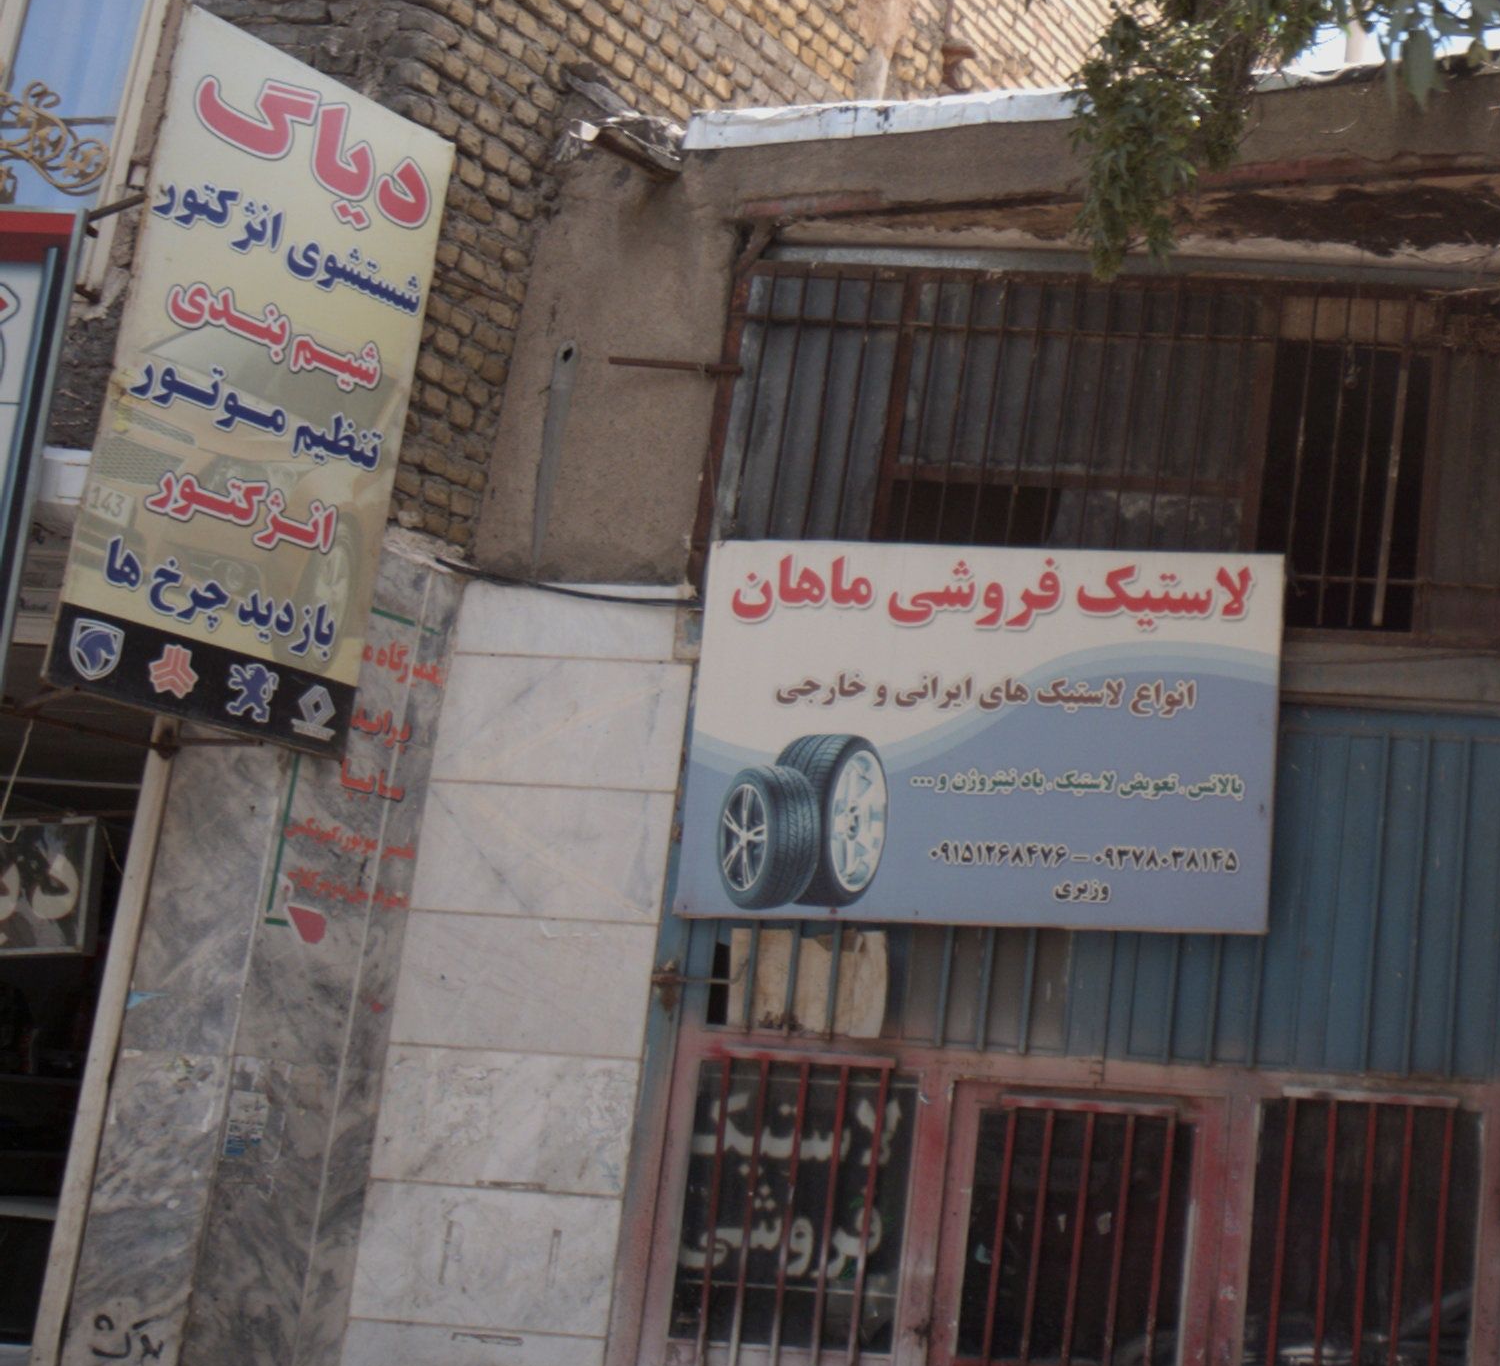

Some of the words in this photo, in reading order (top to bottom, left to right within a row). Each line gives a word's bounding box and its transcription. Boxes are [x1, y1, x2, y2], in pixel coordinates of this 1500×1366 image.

[195, 75, 431, 230] دیاگ
[152, 183, 283, 254] انژکتور
[286, 240, 420, 315] شستشوی
[167, 282, 290, 363] بندی
[290, 334, 383, 391] شیم
[129, 363, 286, 434] موتور
[292, 415, 383, 470] تنظیم
[146, 471, 337, 553] انژکتور
[104, 536, 142, 591] ها
[731, 553, 875, 622] ماهان
[149, 557, 231, 631] چرخ
[886, 557, 1063, 631] فروشی
[1075, 563, 1254, 631] لاستیک
[237, 590, 335, 660] بازدید
[775, 670, 867, 706] خارجی
[872, 683, 889, 707] و
[893, 676, 974, 710] ایرانی
[978, 675, 1030, 713] های
[1035, 678, 1125, 714] لاستیک
[1129, 678, 1198, 717] انواع
[936, 775, 948, 793] و
[951, 766, 1017, 796] نیتروژن
[1020, 767, 1046, 795] باد
[1118, 772, 1178, 799] تعویض
[930, 839, 1069, 869] ۰۹۱۵۱۲۶۸۴۷۶
[1095, 845, 1239, 873] ۰۹۳۷۸۰۳۸۱۴۵
[1053, 881, 1110, 903] وزیری
